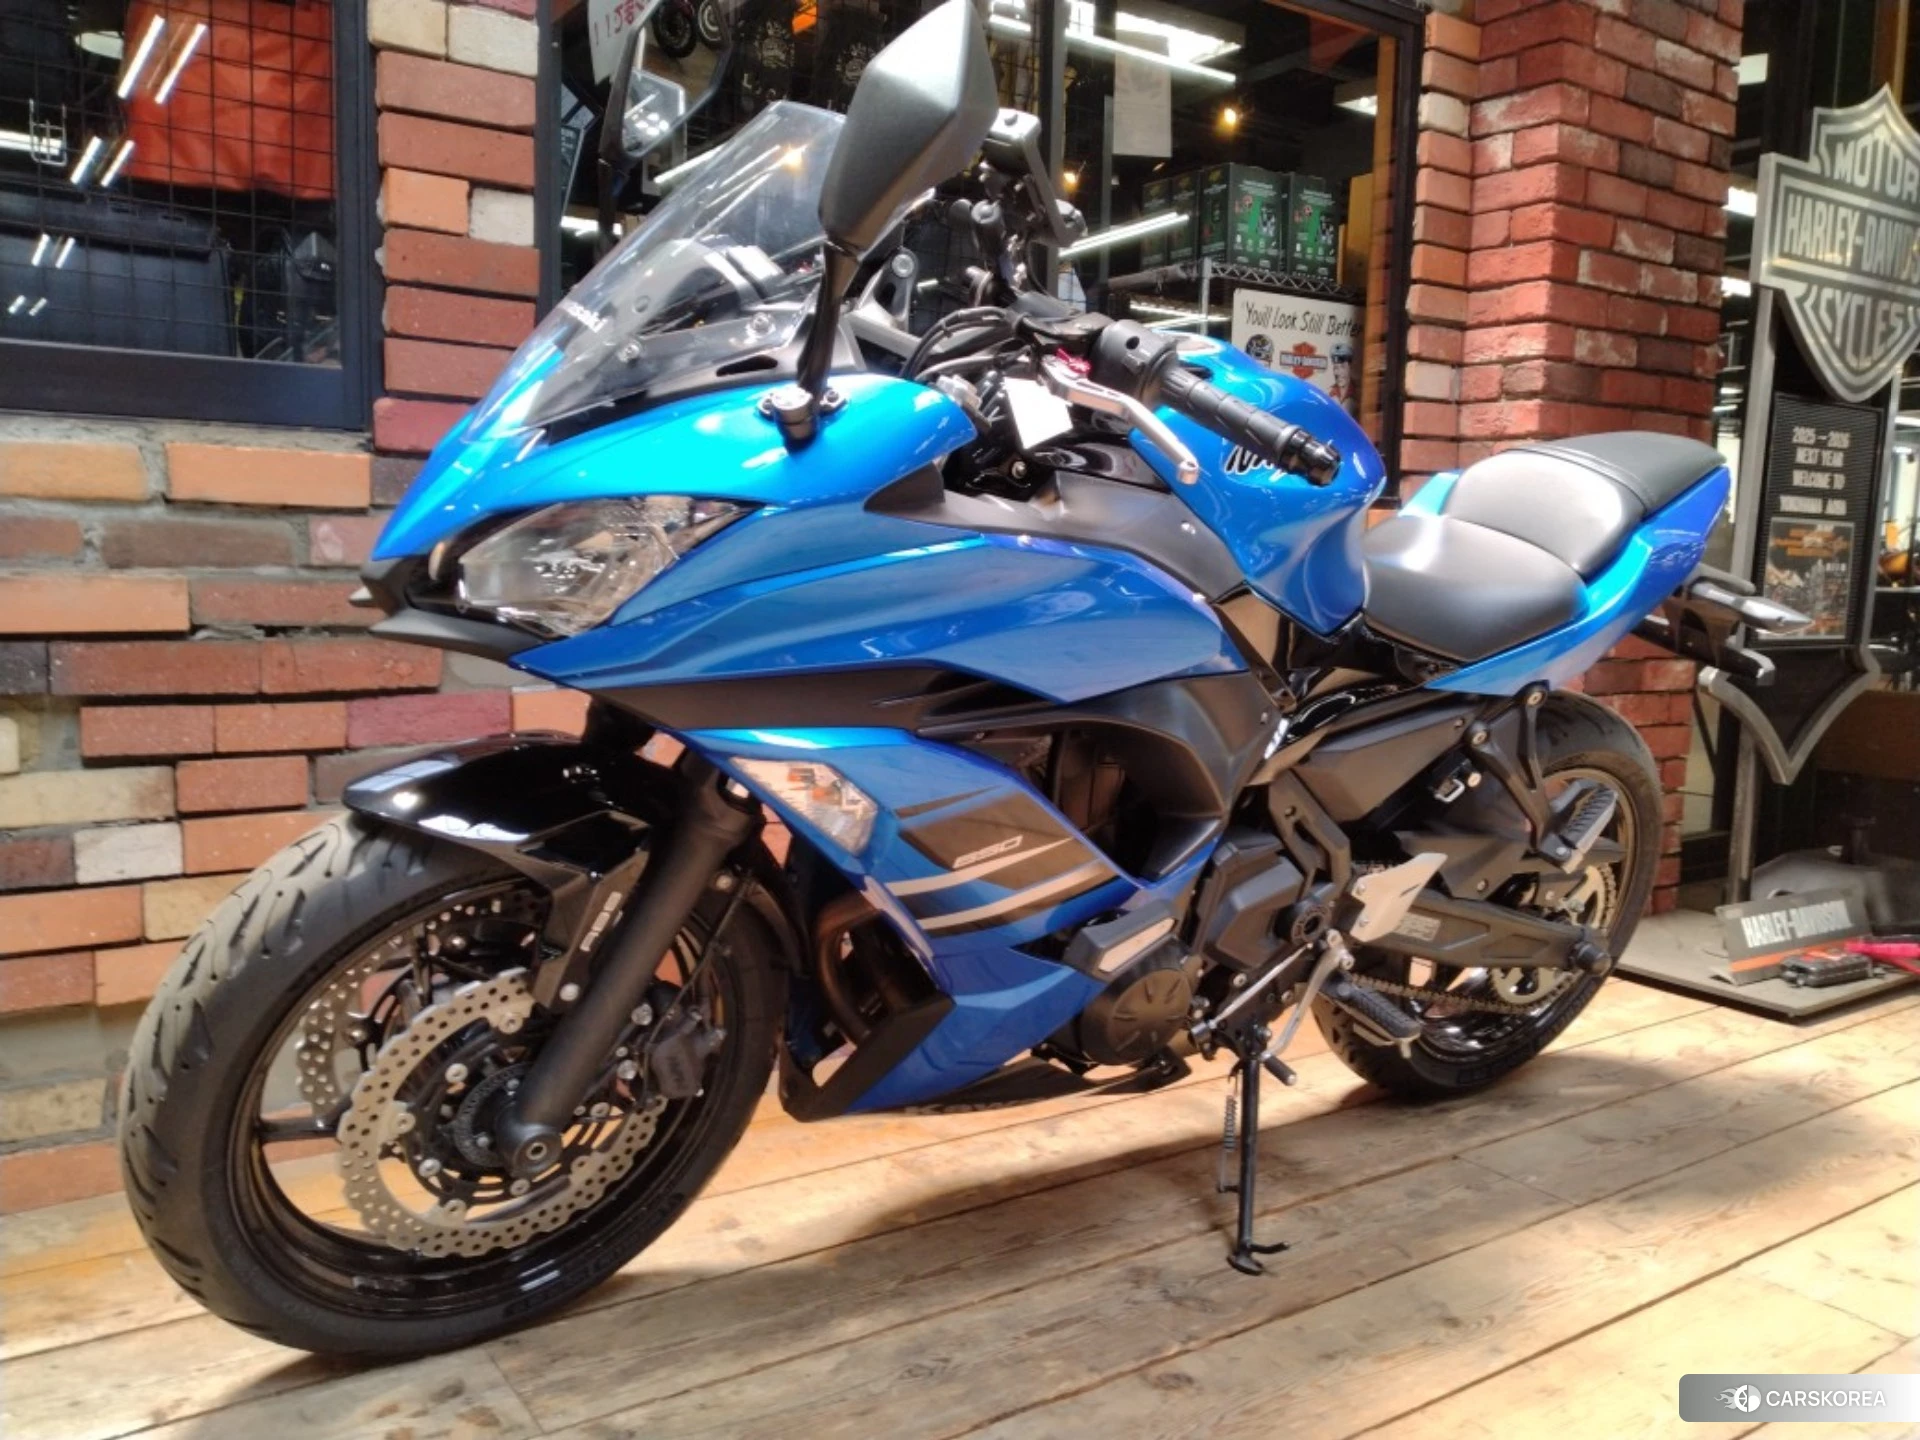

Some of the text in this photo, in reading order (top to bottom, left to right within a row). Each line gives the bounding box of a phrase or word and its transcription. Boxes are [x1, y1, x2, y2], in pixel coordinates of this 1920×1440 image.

[1834, 127, 1920, 203] MOTOR
[1271, 306, 1297, 330] Look
[1300, 310, 1325, 333] Still
[1819, 288, 1905, 369] CYCLES
[1795, 447, 1820, 464] NEXT
[1792, 469, 1831, 488] WELCOME
